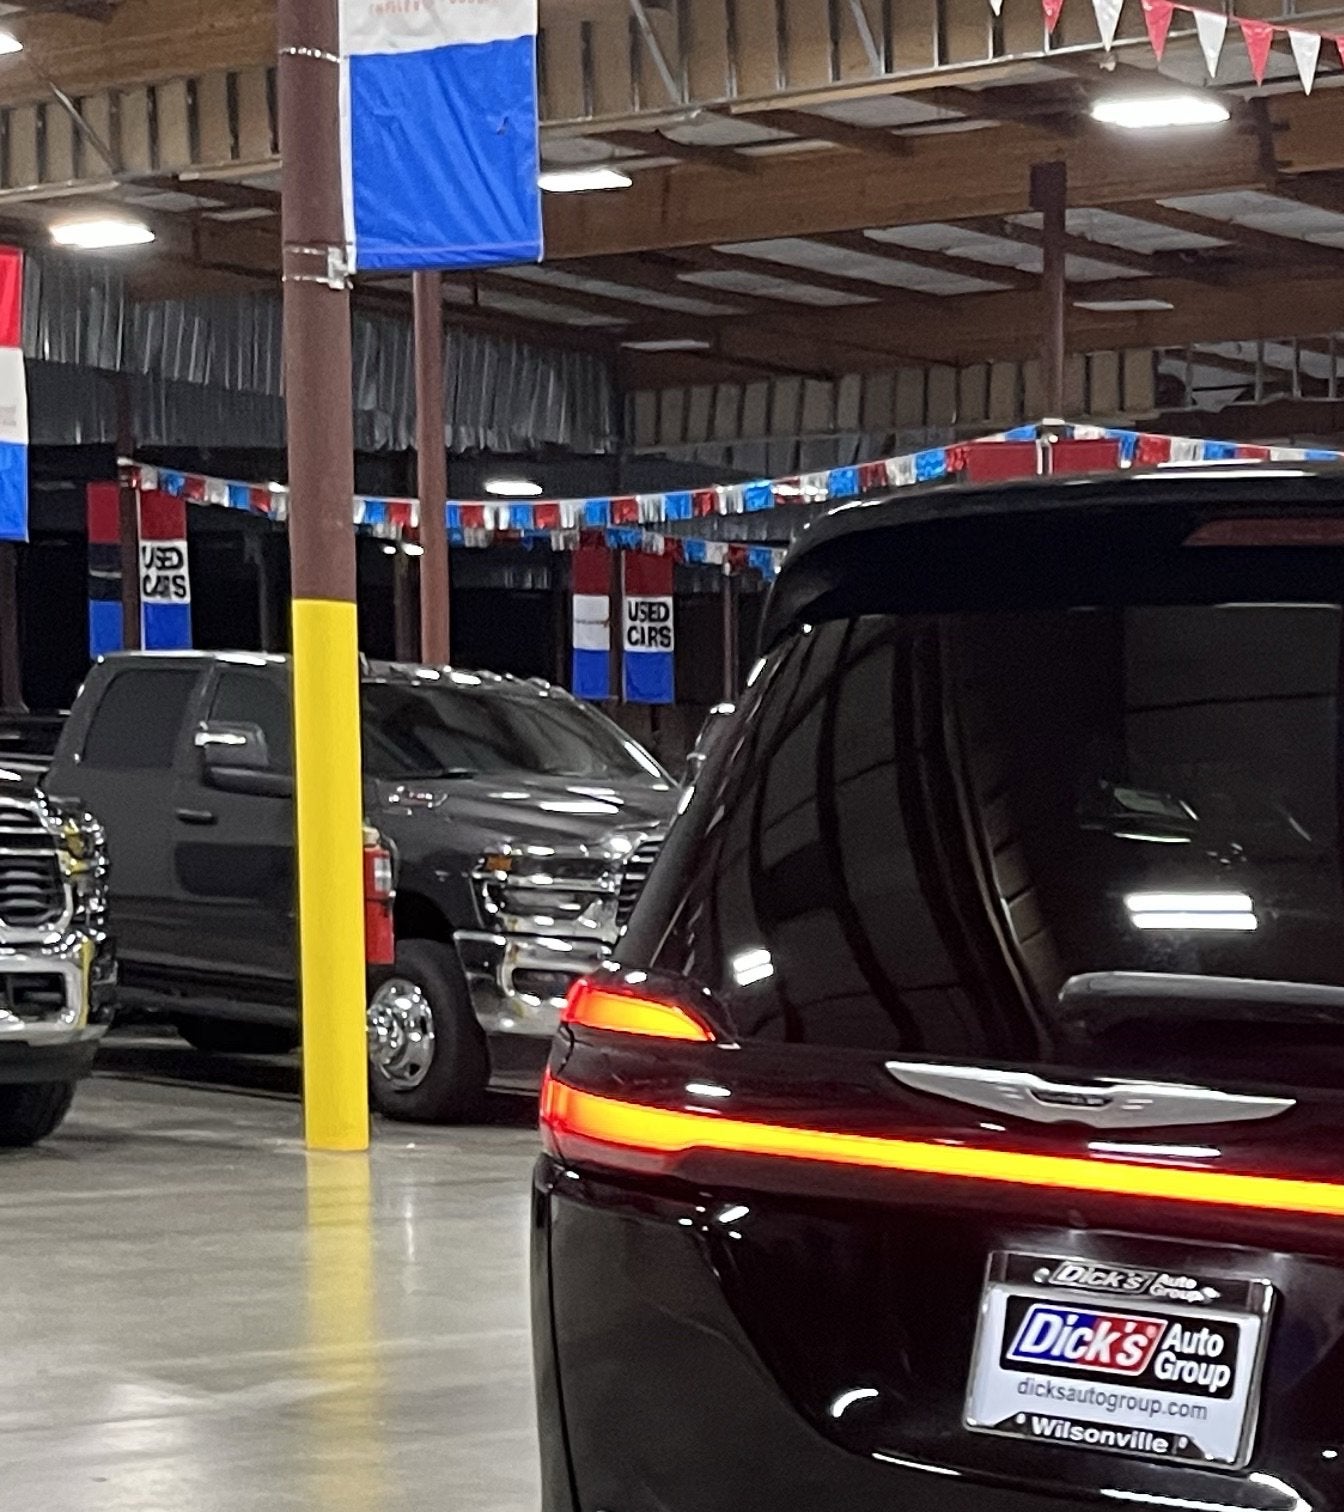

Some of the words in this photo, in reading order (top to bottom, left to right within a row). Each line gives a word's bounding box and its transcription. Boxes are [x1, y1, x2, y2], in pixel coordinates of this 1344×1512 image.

[628, 601, 670, 622] USED
[1056, 1265, 1143, 1290] Dick's
[1154, 1274, 1197, 1289] Auto
[1018, 1311, 1149, 1367] Dick's
[1161, 1322, 1225, 1358] Auto
[1154, 1351, 1231, 1393] Group
[1017, 1377, 1208, 1421] dicksautogroup.com
[1031, 1415, 1170, 1453] Wilsonville
